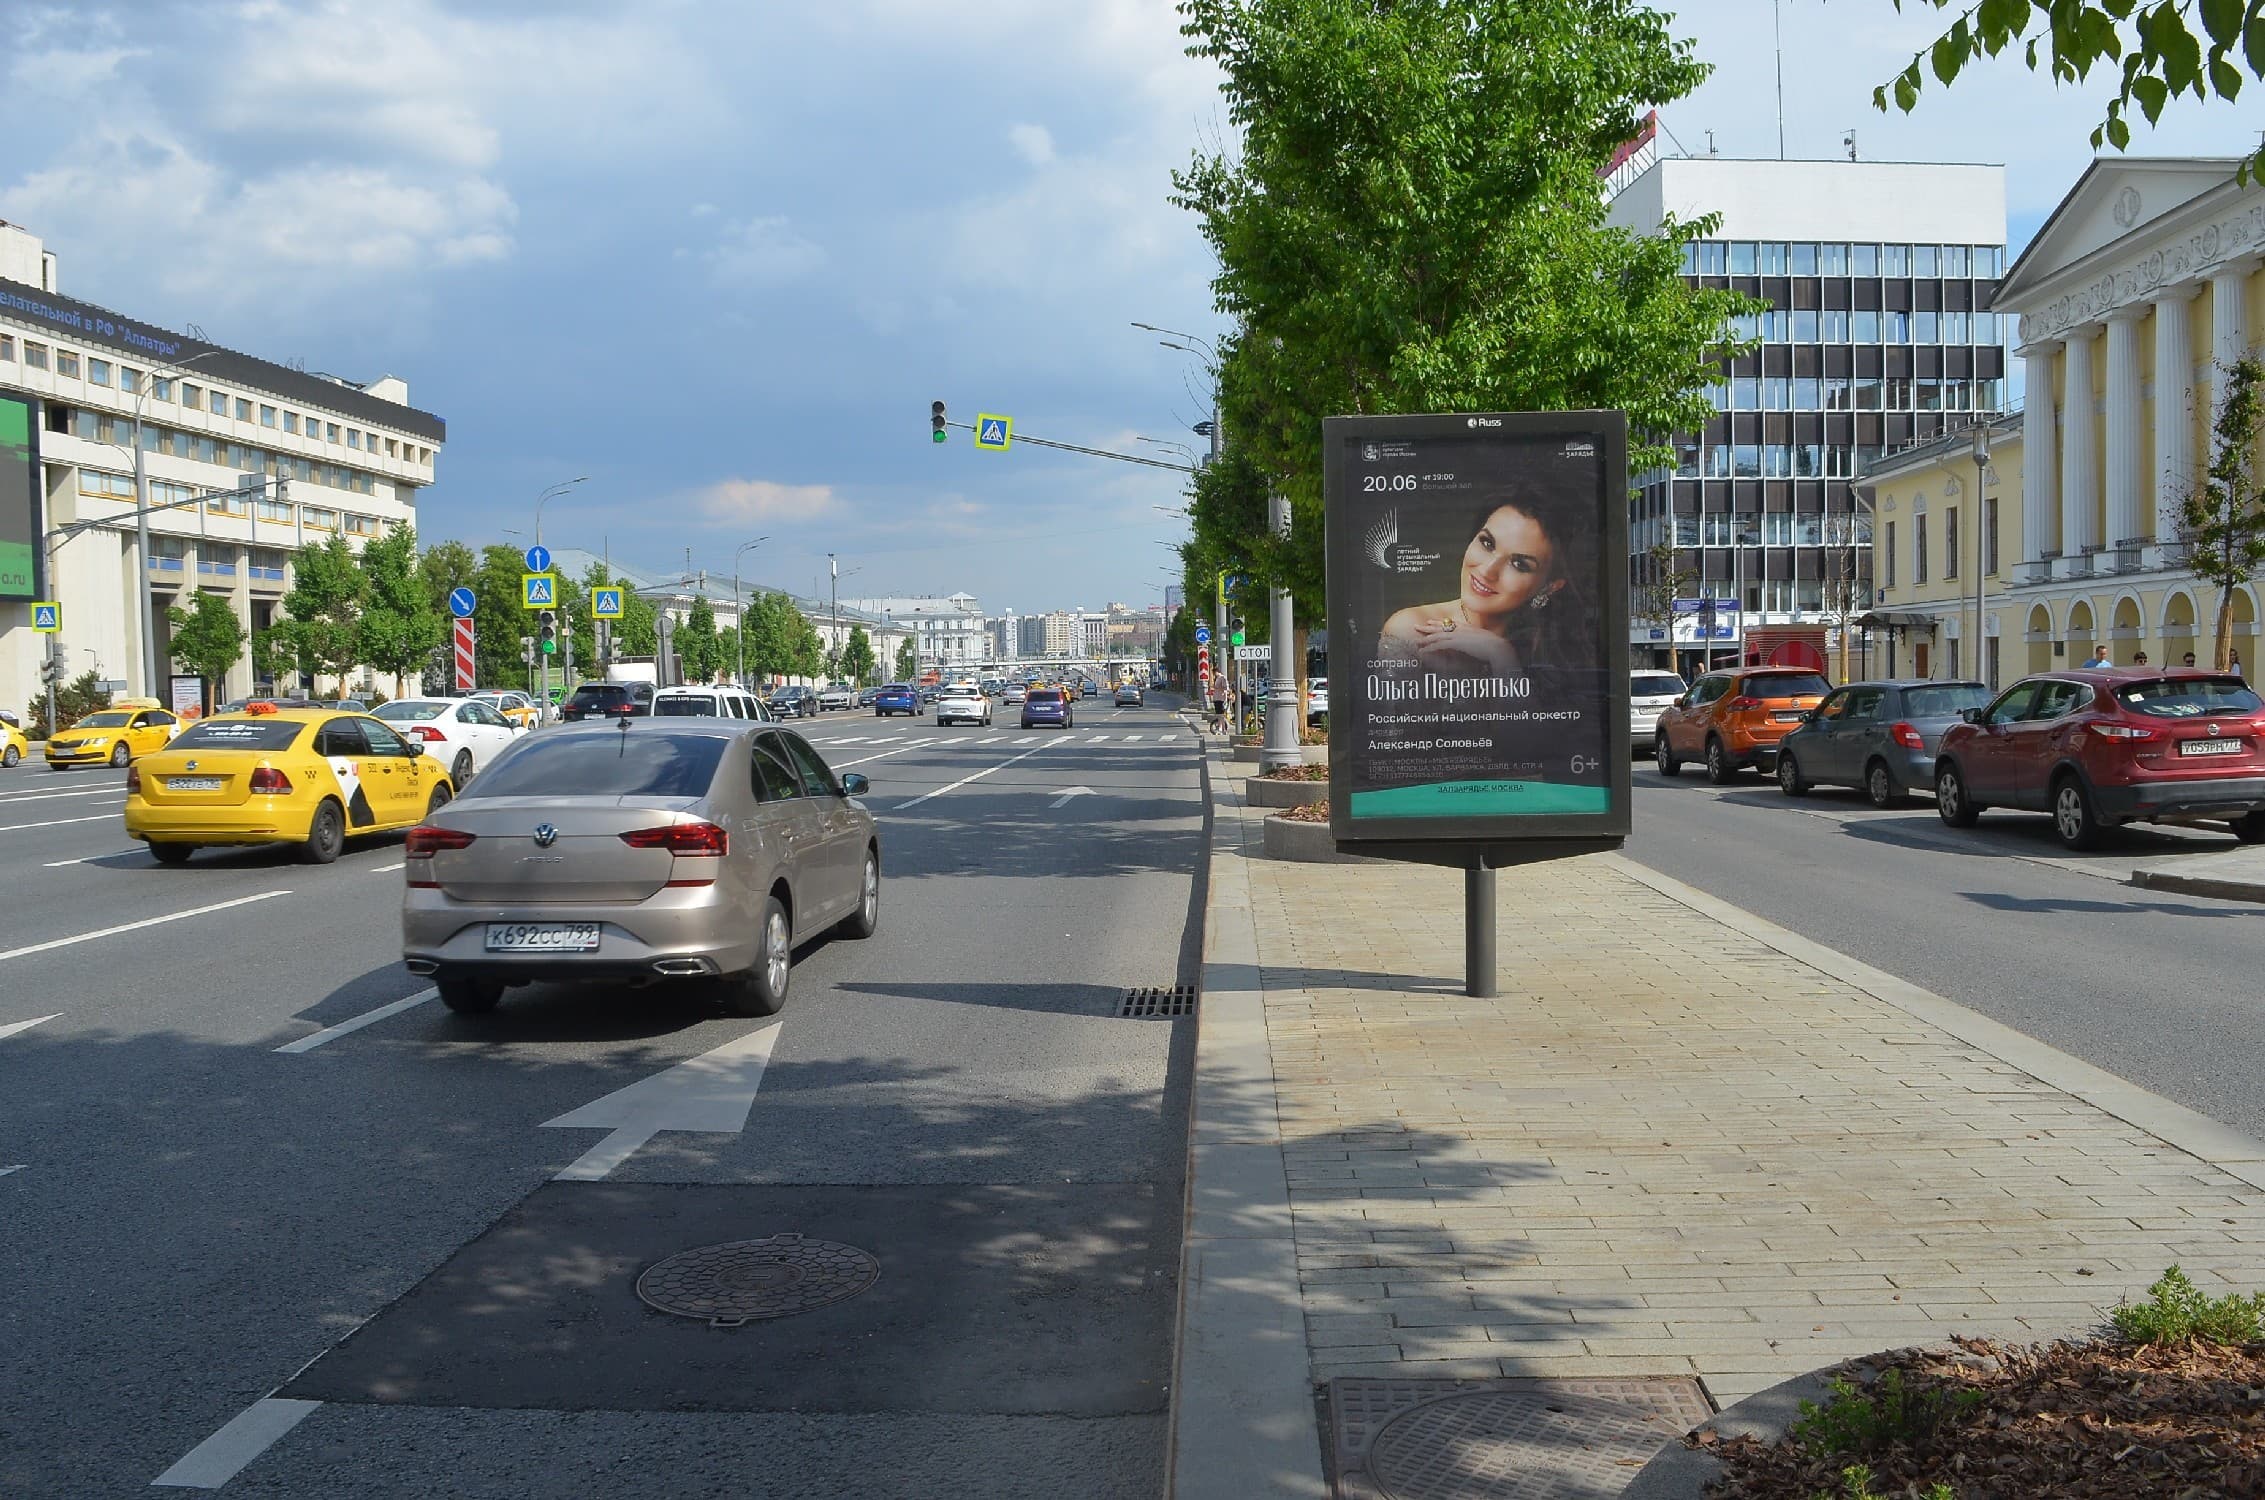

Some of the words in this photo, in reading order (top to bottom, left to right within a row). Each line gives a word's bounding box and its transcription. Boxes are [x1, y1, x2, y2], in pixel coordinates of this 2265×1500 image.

[84, 318, 93, 331] в
[96, 318, 115, 337] РФ
[1478, 418, 1502, 427] Russ
[1363, 474, 1417, 492] 20.06
[1239, 647, 1270, 658] СТОП
[1367, 658, 1418, 670] сопрано
[1367, 674, 1419, 701] Ольга
[1424, 673, 1530, 703] Перетятько
[1368, 712, 1439, 724] Российский
[1441, 710, 1529, 723] национальный
[1531, 710, 1581, 722] оркестр
[1368, 740, 1433, 751] Александр
[1435, 738, 1493, 749] Соловьёв
[1570, 754, 1599, 774] 6+
